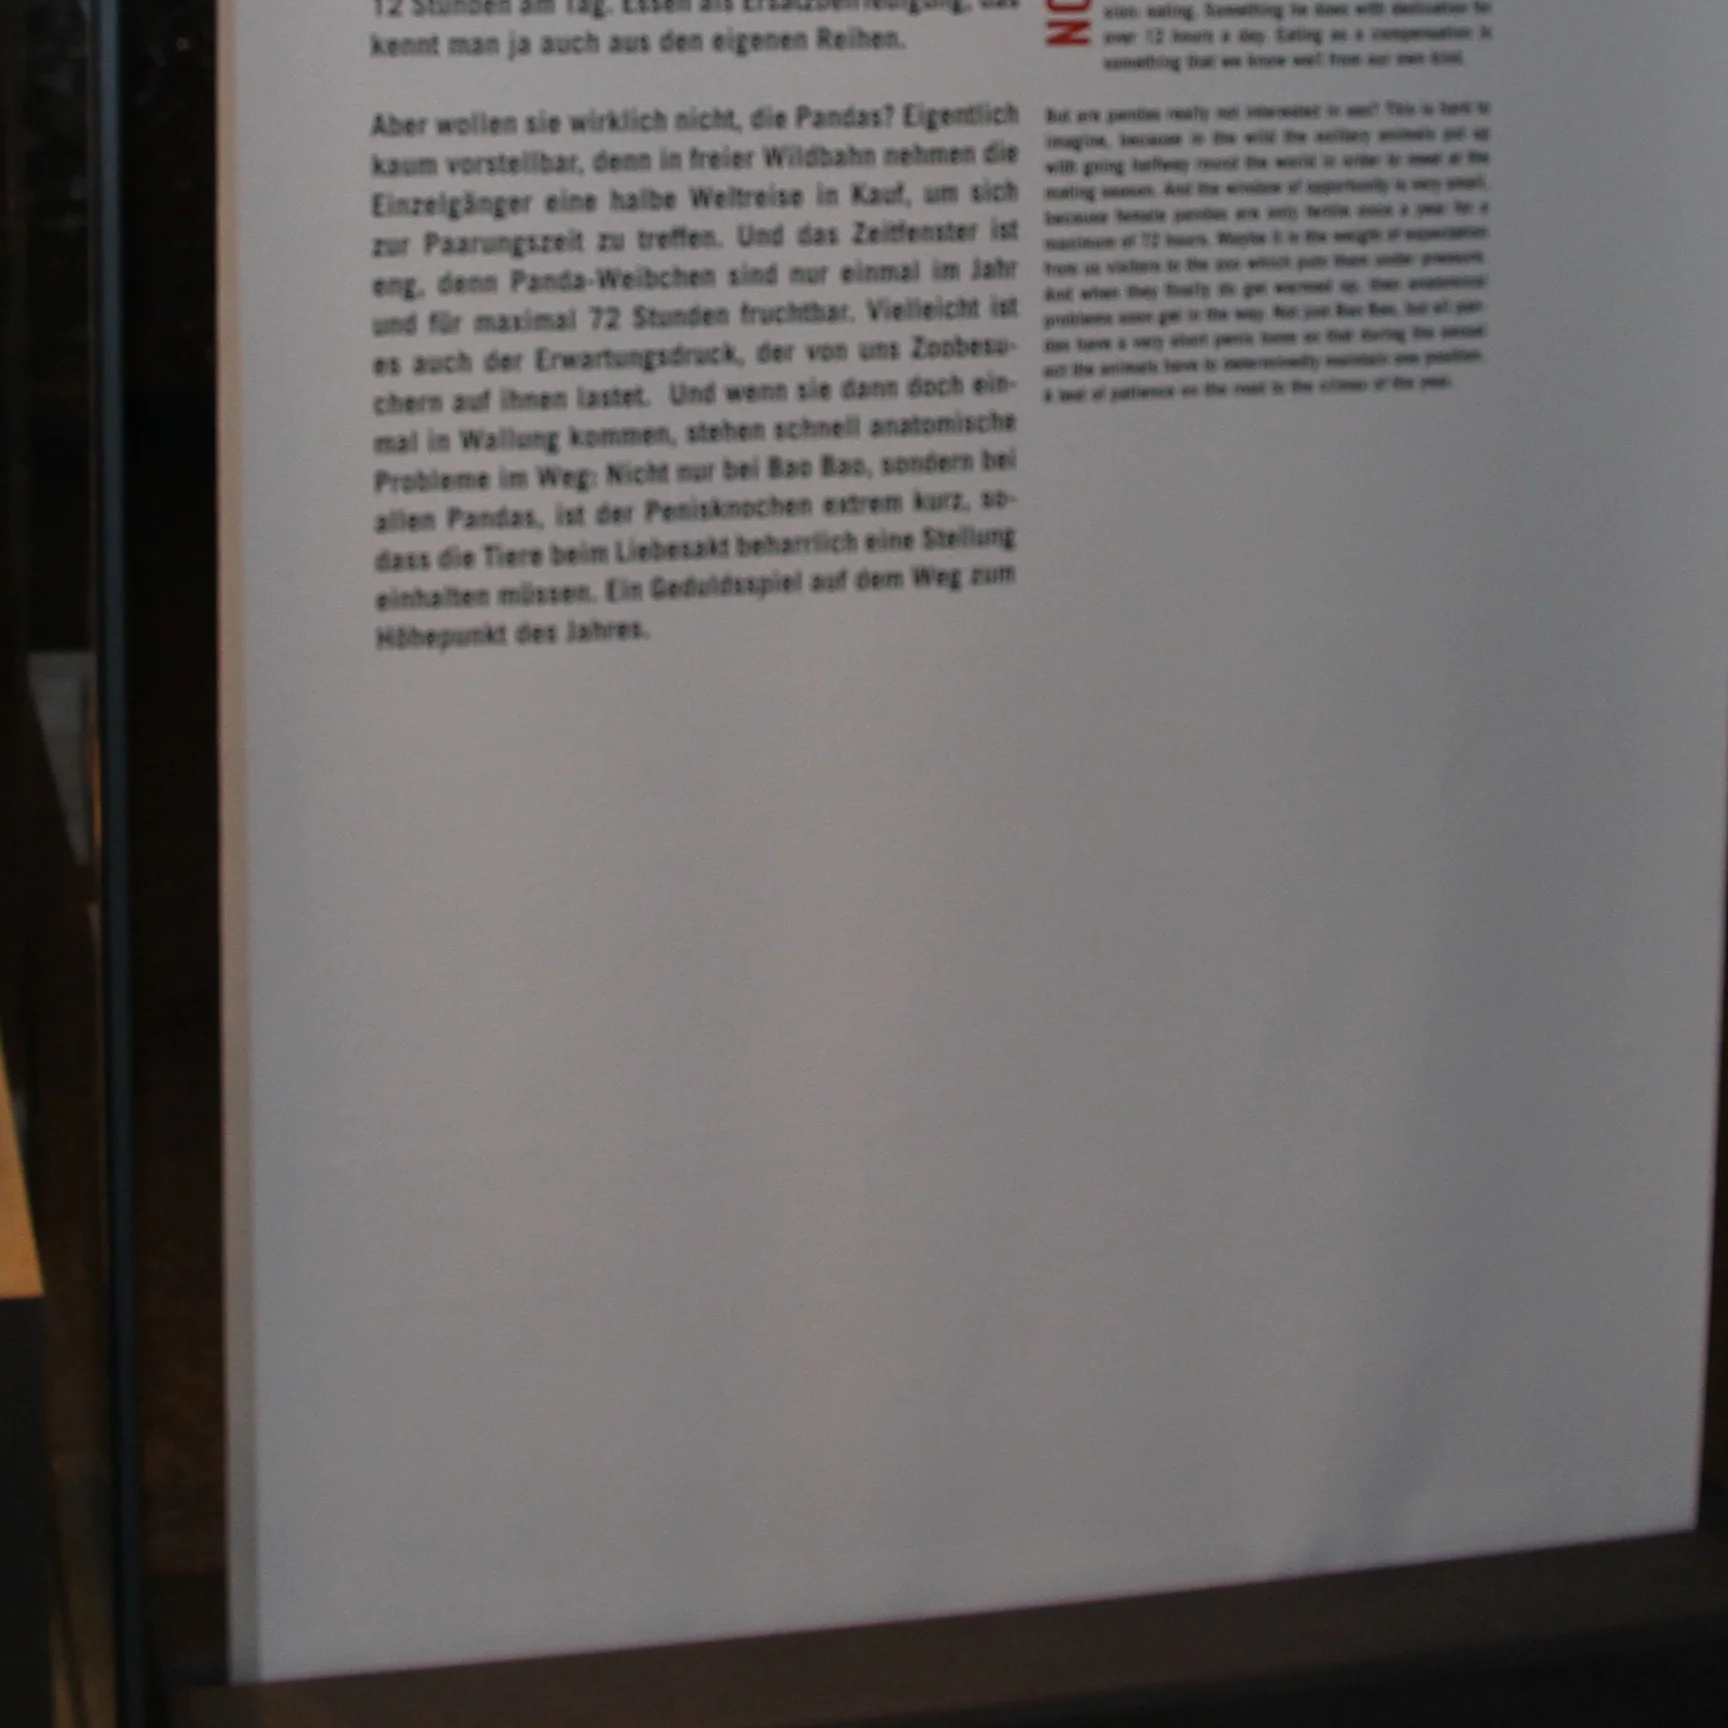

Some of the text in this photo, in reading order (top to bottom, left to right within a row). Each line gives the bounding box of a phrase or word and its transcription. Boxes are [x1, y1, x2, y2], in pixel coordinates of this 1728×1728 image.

[369, 34, 440, 58] kennt
[447, 35, 500, 57] man
[507, 34, 532, 61] ja
[539, 31, 600, 56] auch
[608, 34, 652, 54] aus
[658, 29, 704, 54] den
[710, 31, 809, 57] eigenen
